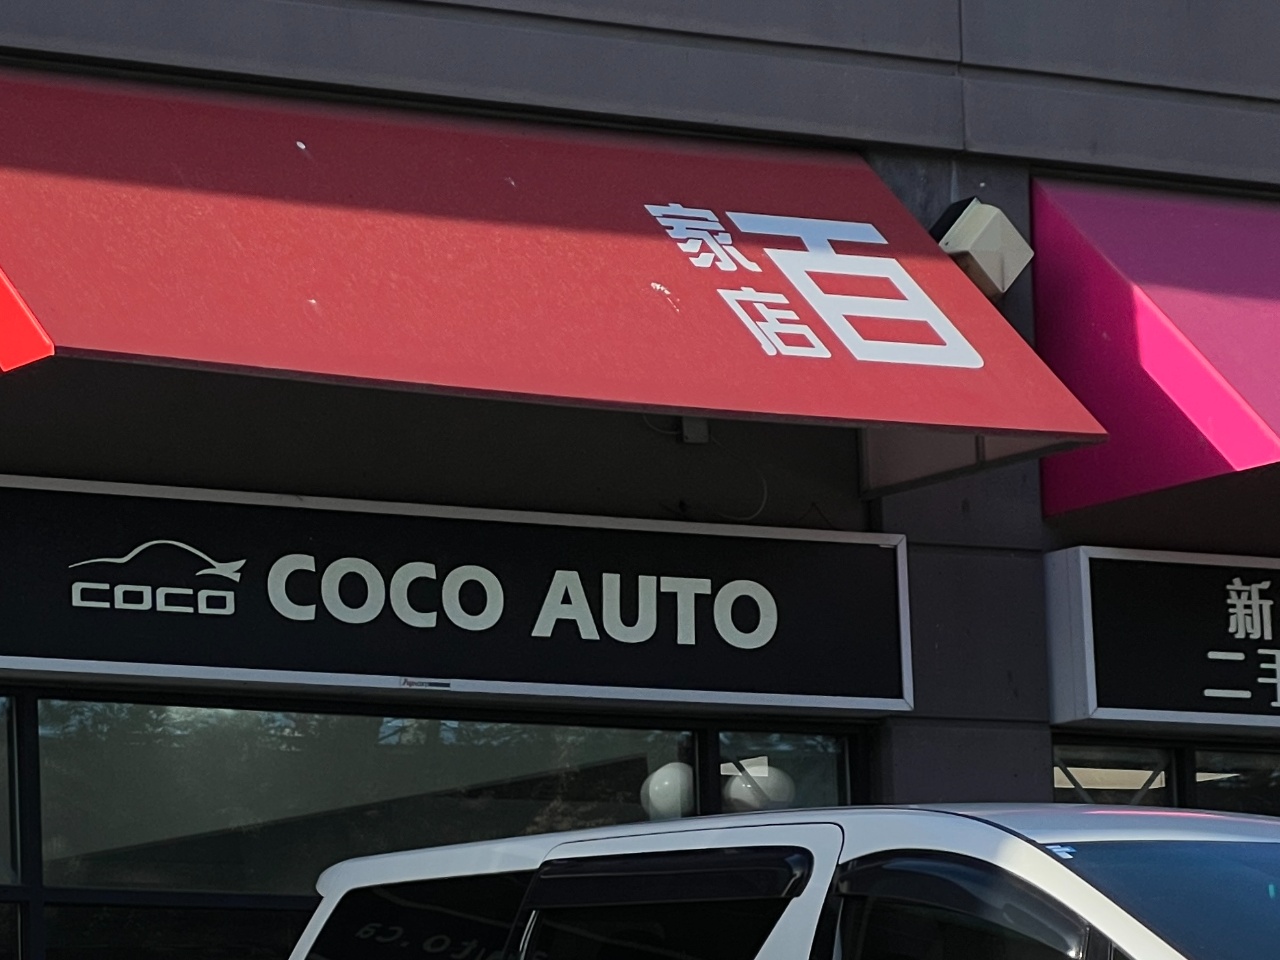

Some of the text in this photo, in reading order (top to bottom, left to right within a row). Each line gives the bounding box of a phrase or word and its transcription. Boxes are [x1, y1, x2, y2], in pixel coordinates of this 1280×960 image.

[71, 581, 236, 615] COCO
[267, 553, 778, 650] COCO AUTO
